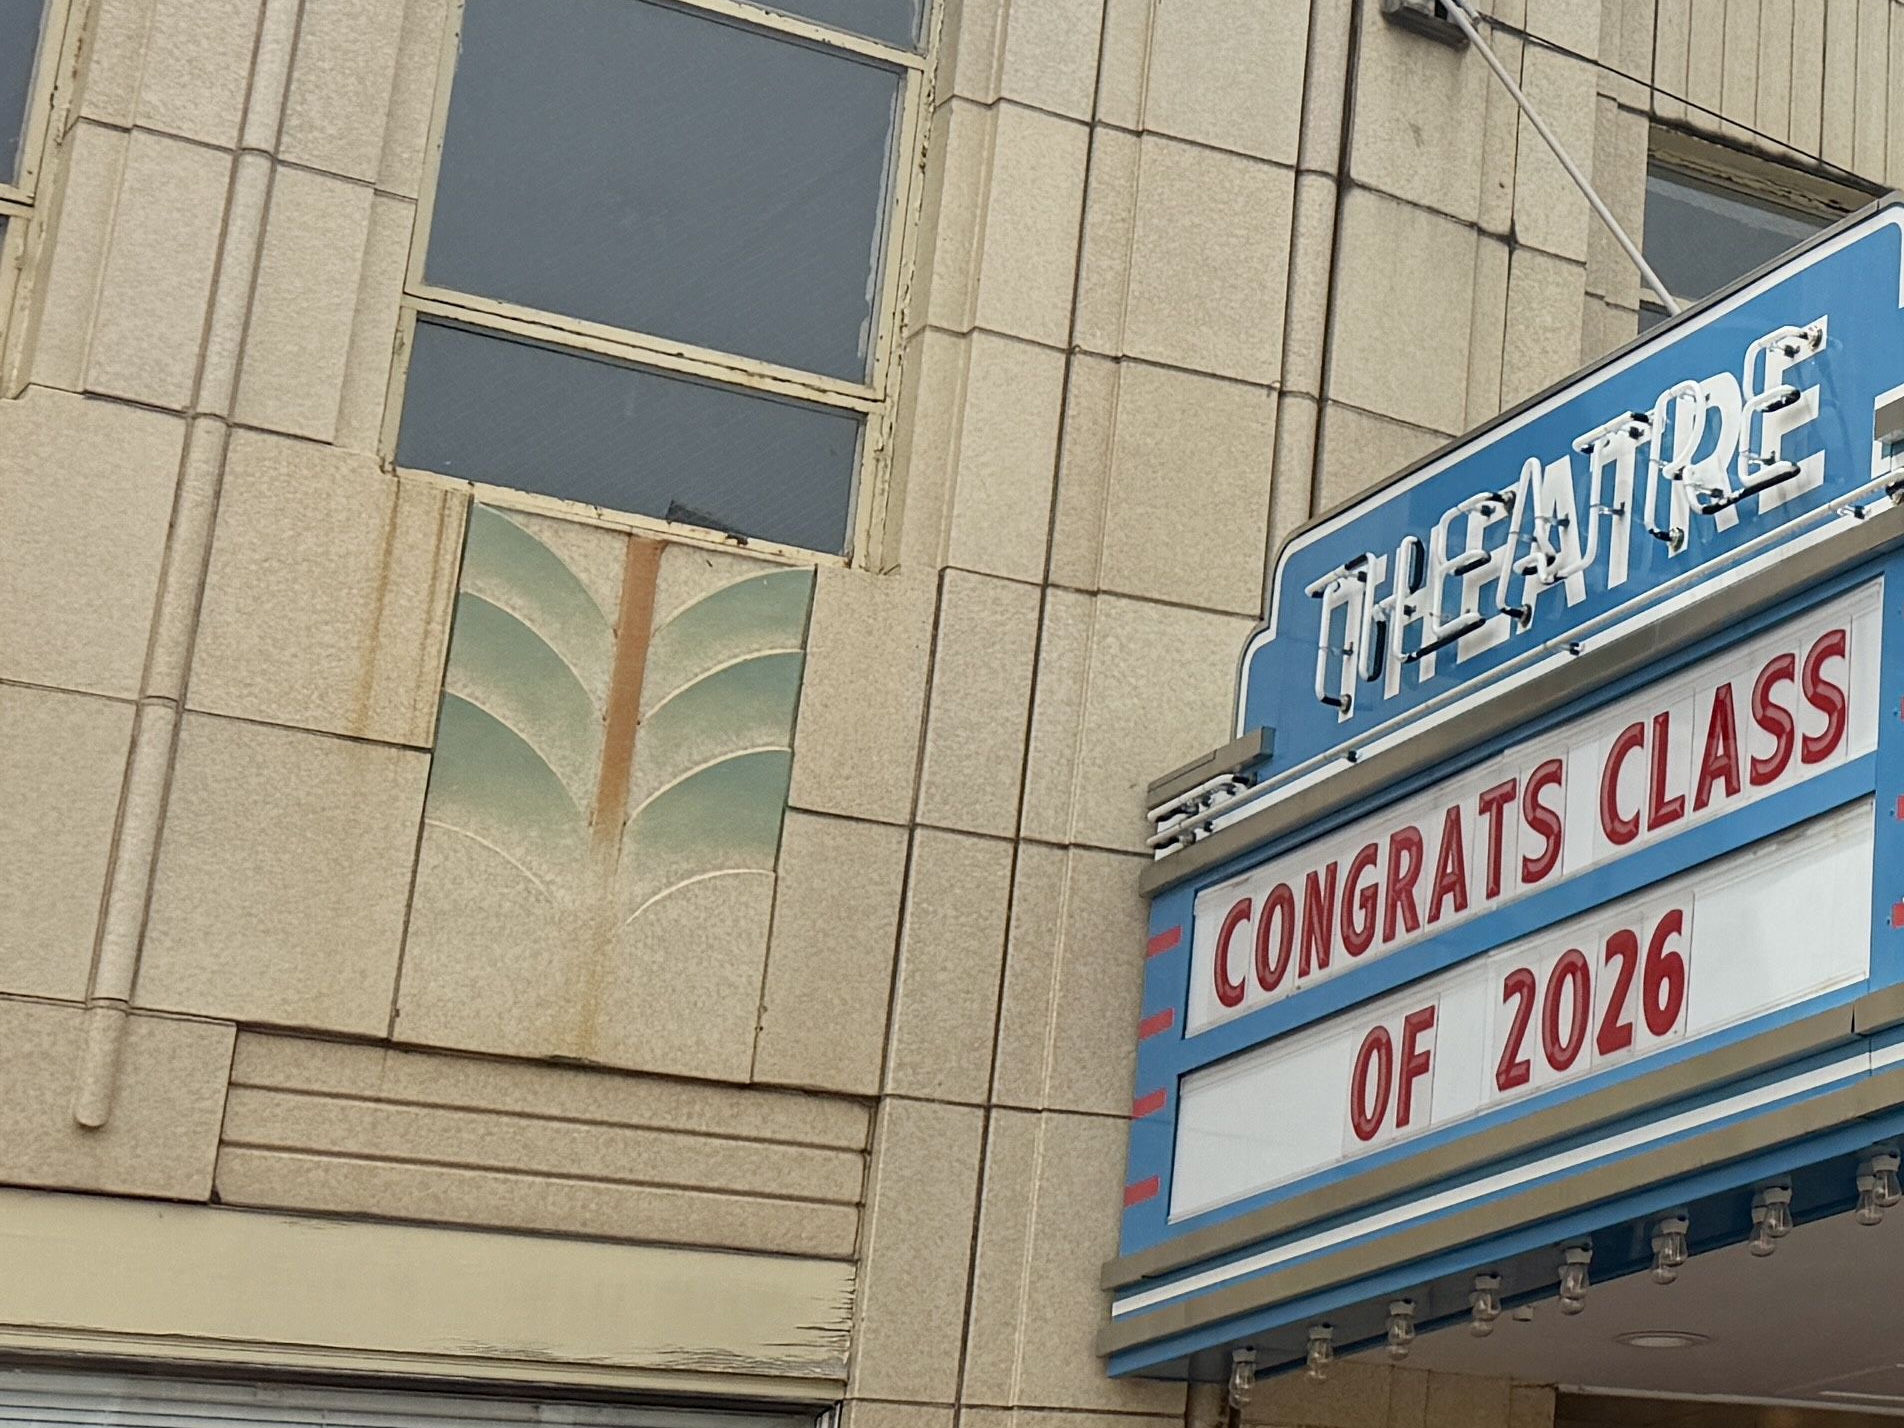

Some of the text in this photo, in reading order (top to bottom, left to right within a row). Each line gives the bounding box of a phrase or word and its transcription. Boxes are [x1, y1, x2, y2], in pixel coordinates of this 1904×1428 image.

[1305, 315, 1828, 723] THEATRE
[1213, 628, 1848, 1008] CONGRATS CLASS
[1349, 908, 1685, 1142] OF 2026
